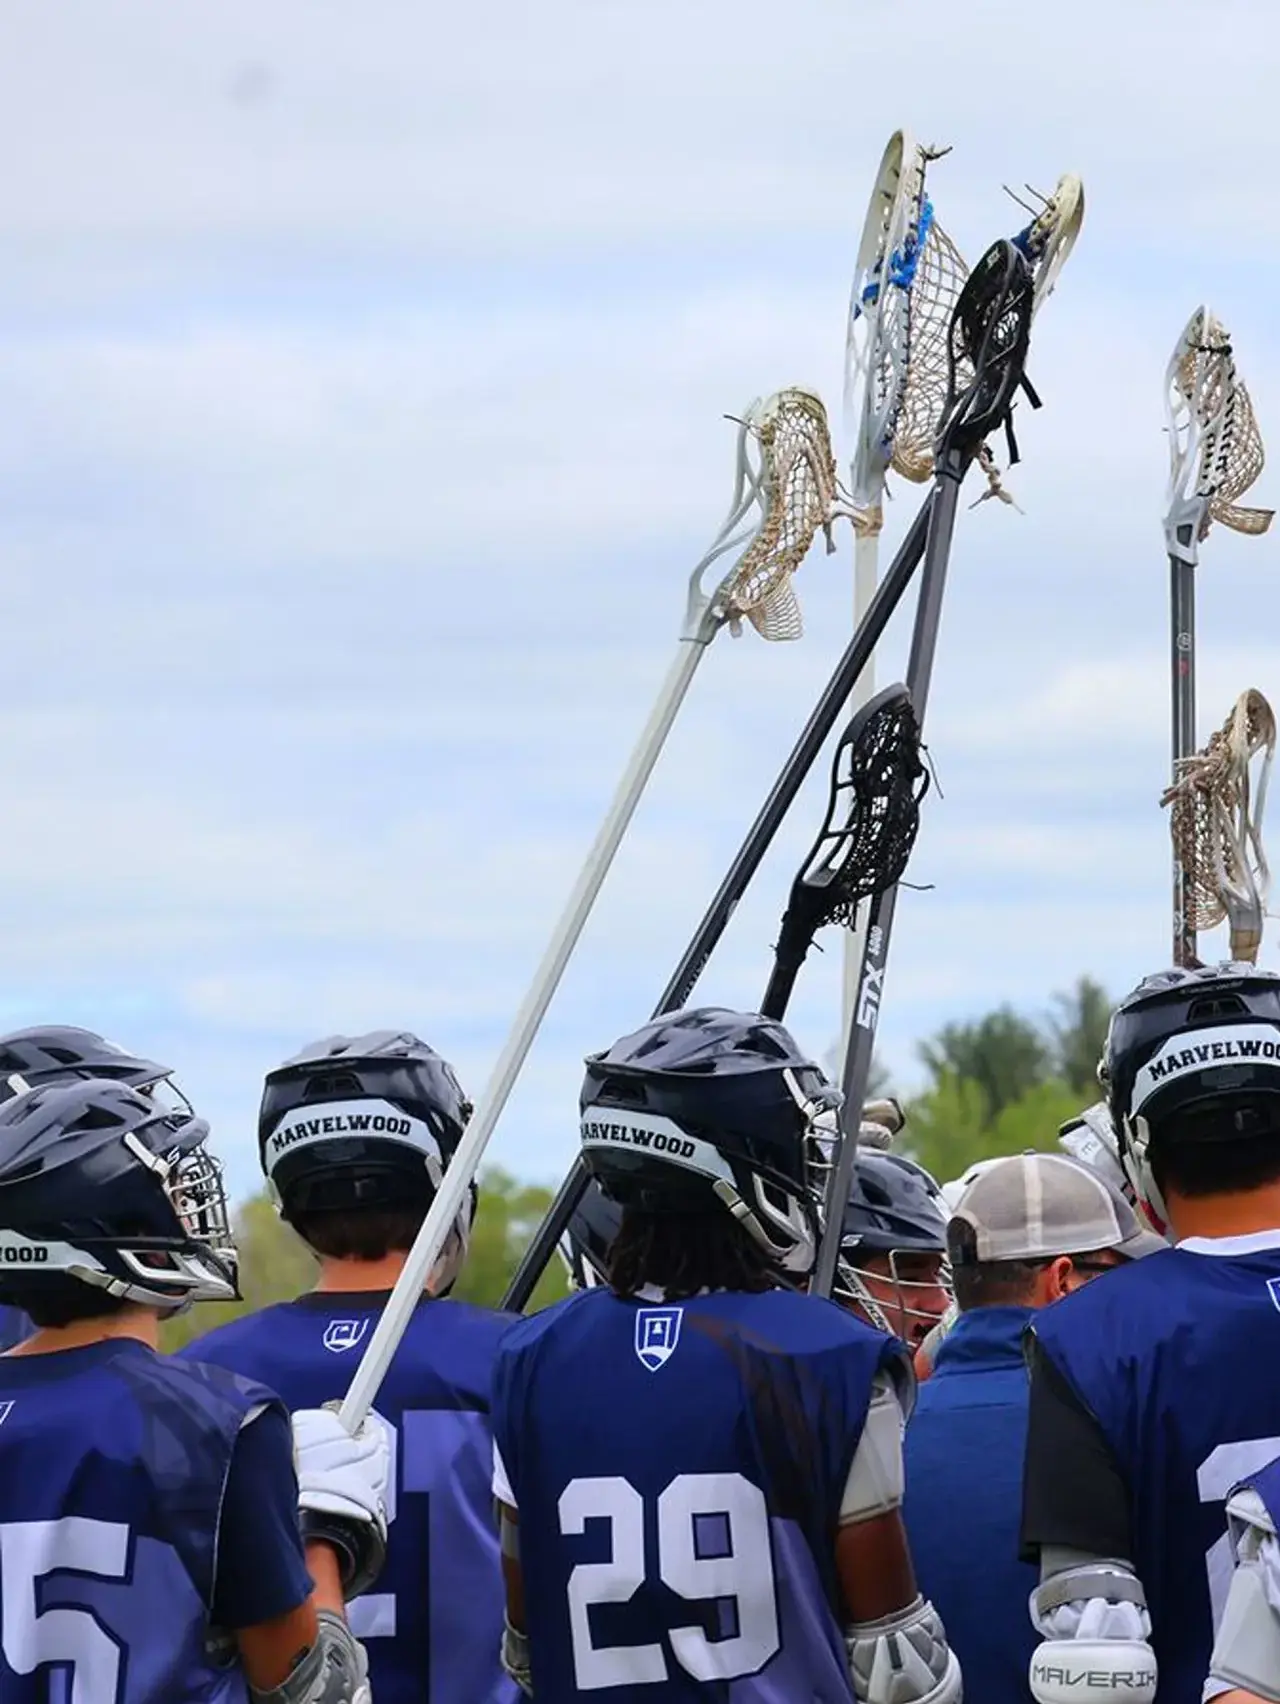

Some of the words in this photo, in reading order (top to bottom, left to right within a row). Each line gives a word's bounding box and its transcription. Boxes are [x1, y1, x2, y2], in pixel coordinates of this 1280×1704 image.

[857, 959, 883, 1029] STX
[271, 1114, 412, 1152] MARVELWOOD
[581, 1122, 695, 1158] ARVELWOOD
[558, 1473, 780, 1690] 29
